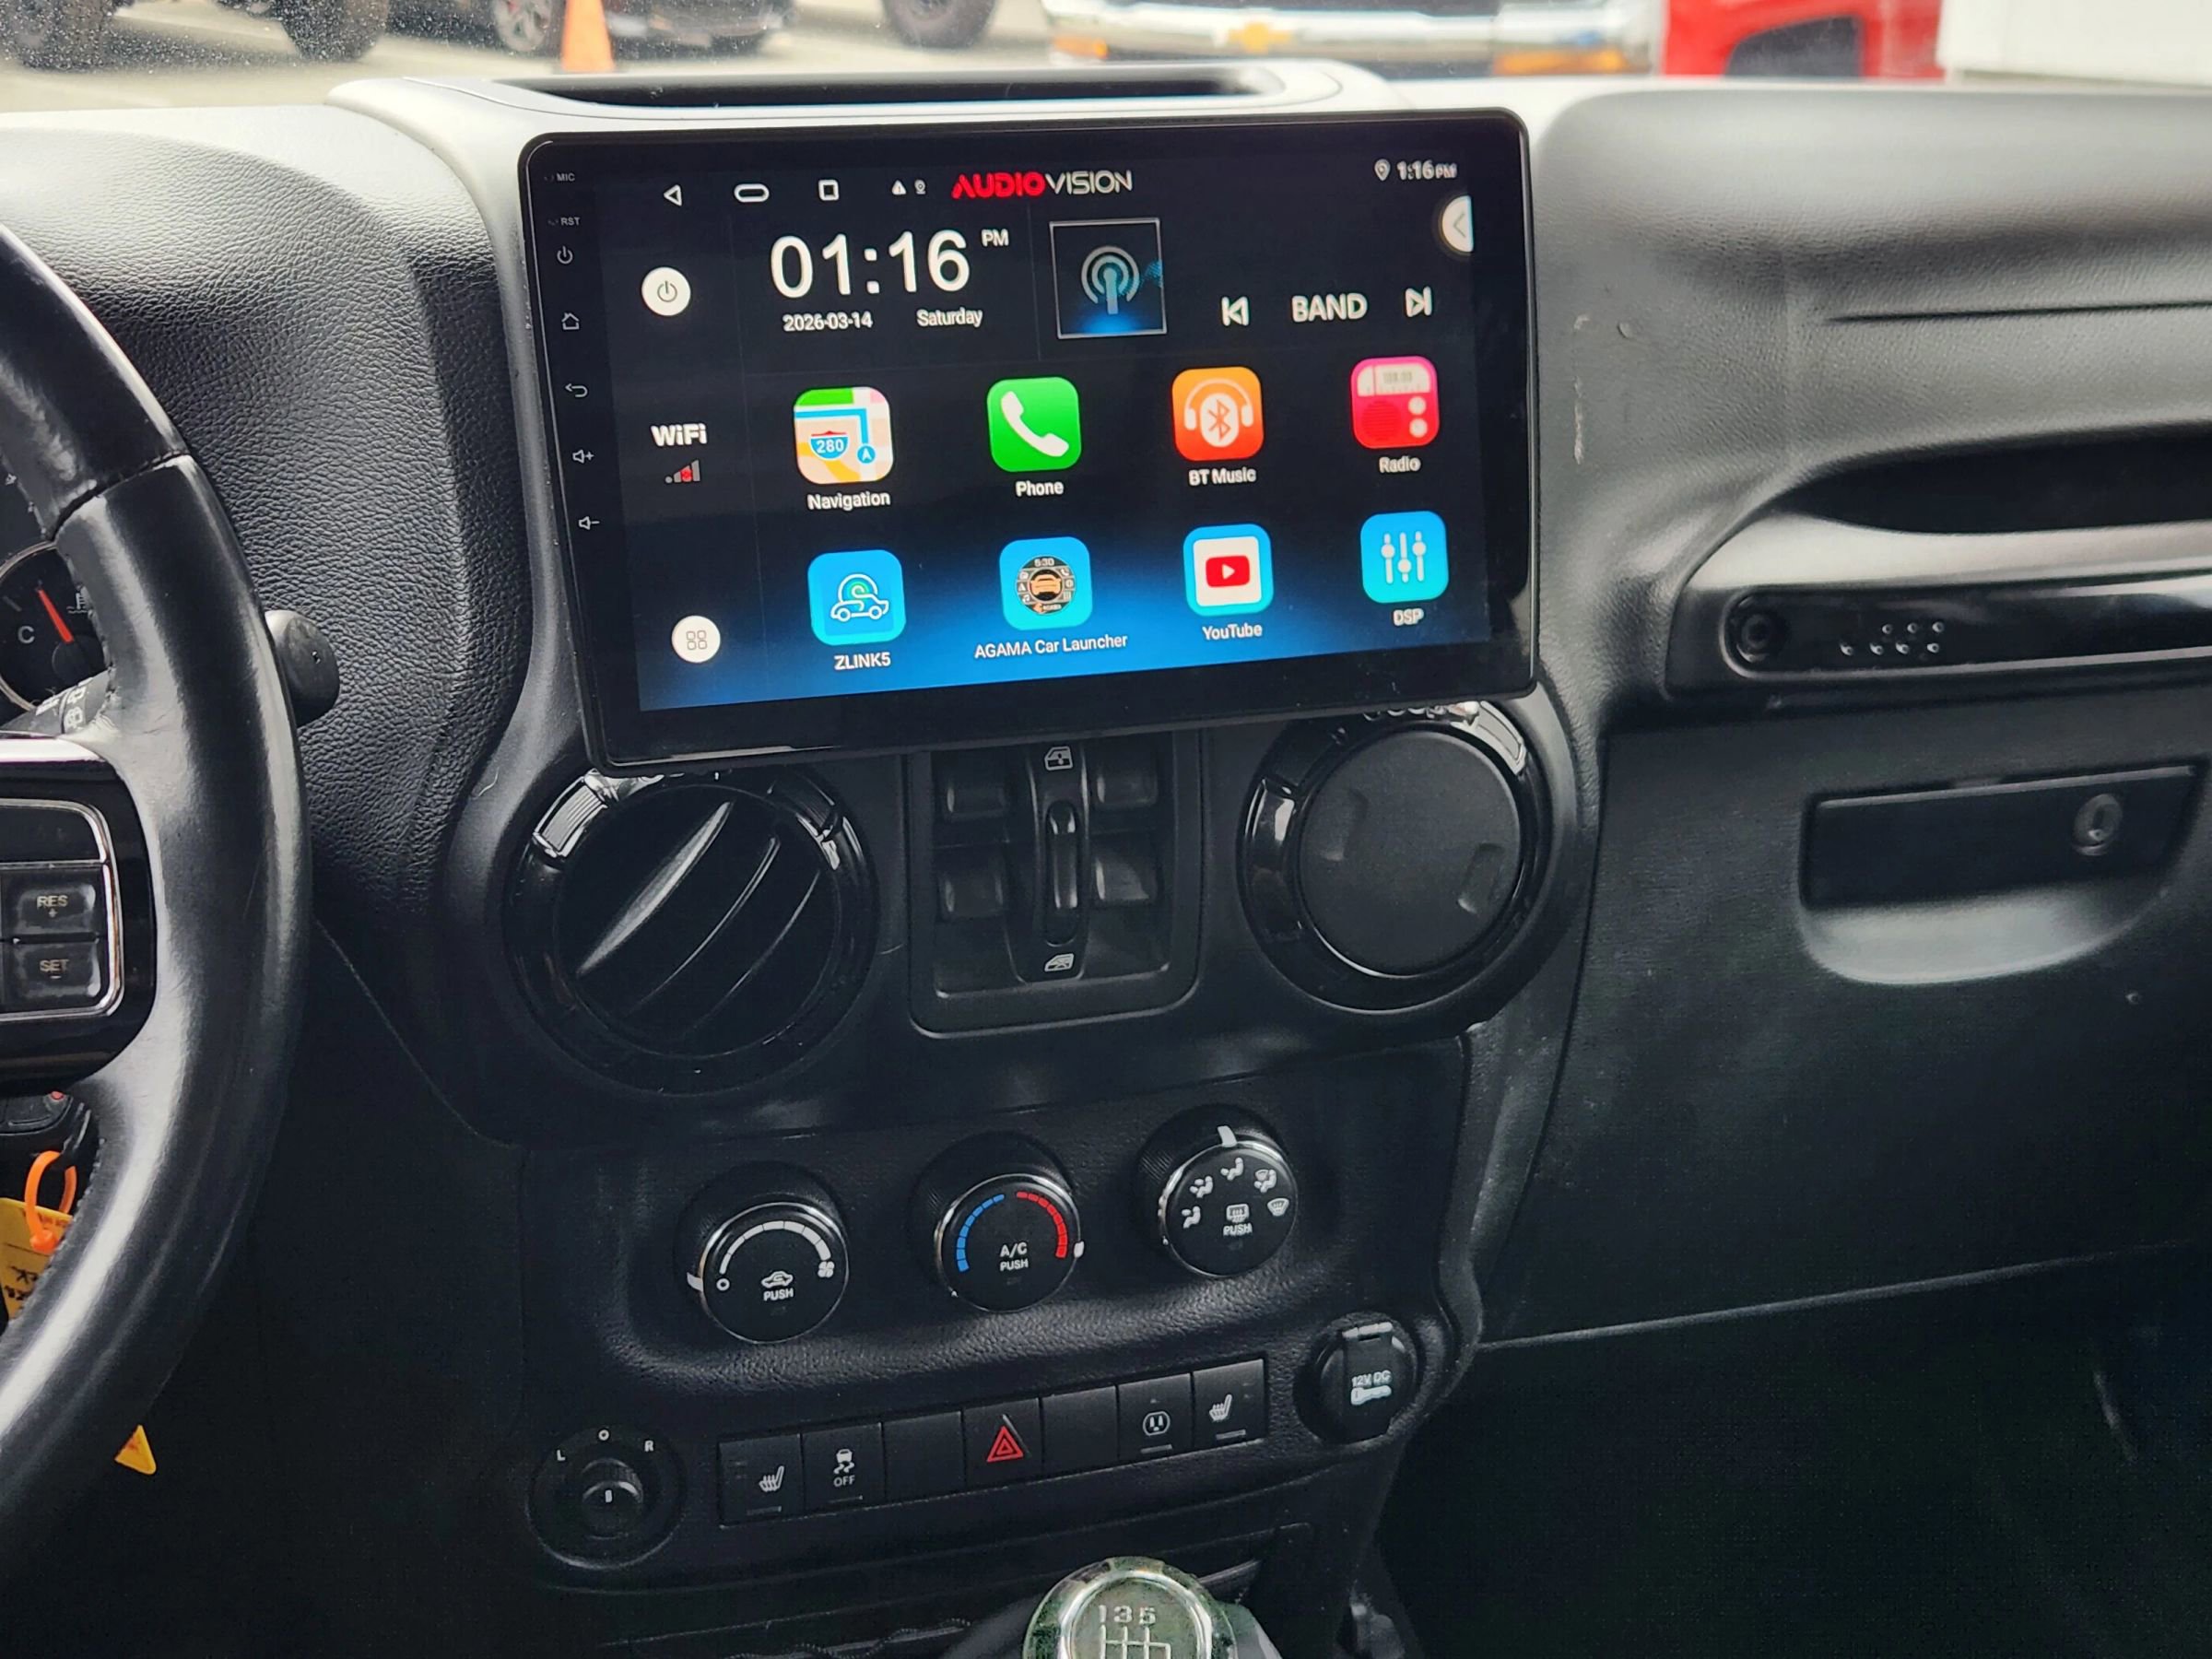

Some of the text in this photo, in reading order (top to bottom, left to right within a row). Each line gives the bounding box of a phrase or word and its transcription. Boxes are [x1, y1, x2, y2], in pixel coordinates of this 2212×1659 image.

[556, 172, 576, 182] MIC
[951, 170, 1133, 199] AUDIOVISION
[559, 217, 581, 227] RST
[771, 229, 1010, 299] 01:16 PM
[1291, 292, 1369, 323] BAND
[782, 308, 984, 333] 2026-03-14 Saturday
[650, 422, 708, 448] WiFi
[815, 438, 846, 455] 280
[1379, 456, 1422, 474] Radio
[1188, 466, 1257, 487] BT Music
[1015, 479, 1065, 497] Phone
[806, 490, 891, 512] Navigation
[1393, 607, 1425, 628] DSP
[18, 625, 36, 644] C
[1202, 621, 1264, 641] YouTube
[973, 633, 1129, 660] AGAMA Car Launcher
[833, 652, 892, 672] ZLINK5
[37, 894, 69, 908] RES
[40, 959, 70, 972] SET
[1223, 1222, 1253, 1237] PUSH
[1000, 1241, 1029, 1258] A/C
[999, 1258, 1030, 1272] PUSH
[763, 1288, 794, 1301] PUSH
[1351, 1370, 1393, 1388] 12V DC
[556, 1449, 566, 1462] L
[644, 1440, 654, 1453] R
[833, 1475, 856, 1488] OFF
[1113, 1605, 1134, 1624] 3
